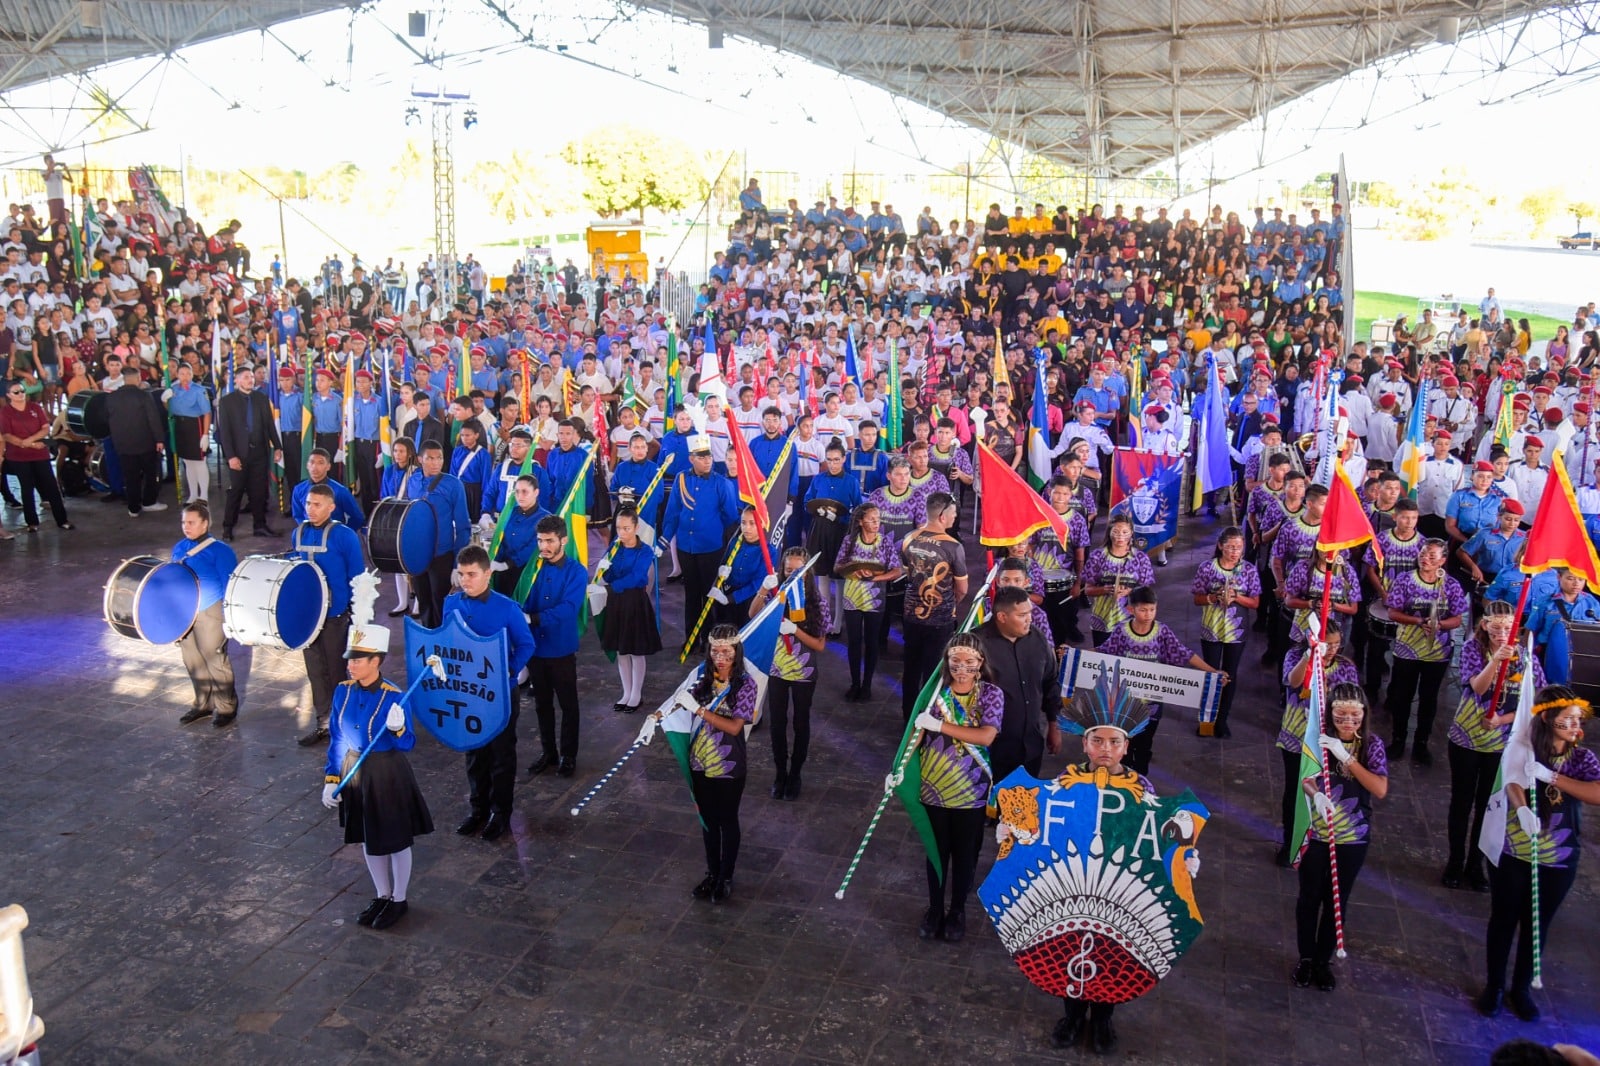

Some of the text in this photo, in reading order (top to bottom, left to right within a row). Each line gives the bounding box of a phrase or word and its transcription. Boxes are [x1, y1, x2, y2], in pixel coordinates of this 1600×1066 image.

[433, 644, 474, 663] BANDA
[447, 662, 462, 677] DE
[1082, 661, 1114, 673] ESCOA
[1119, 668, 1158, 681] STADUAL
[1158, 675, 1200, 689] INDÍGENA
[421, 677, 495, 702] PERCUSSÃO
[1126, 680, 1160, 692] UGUSTO
[1161, 686, 1185, 697] SILVA
